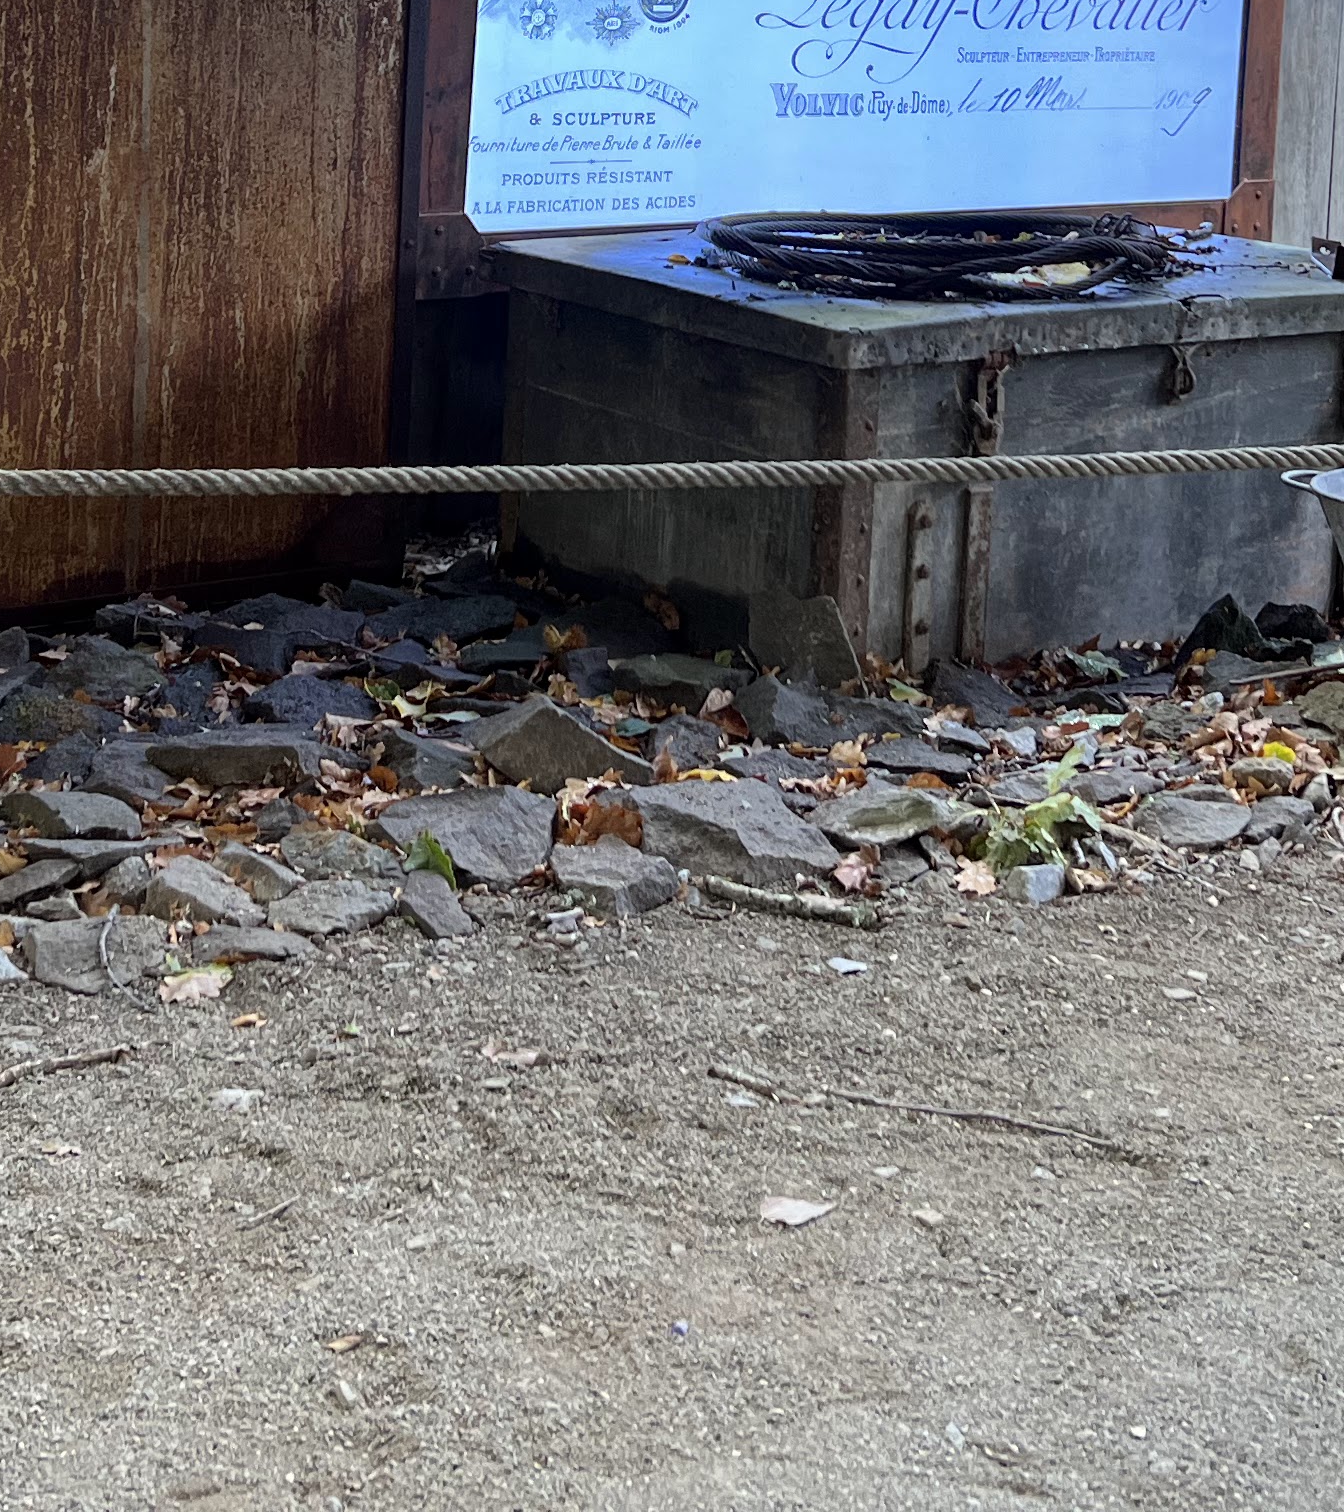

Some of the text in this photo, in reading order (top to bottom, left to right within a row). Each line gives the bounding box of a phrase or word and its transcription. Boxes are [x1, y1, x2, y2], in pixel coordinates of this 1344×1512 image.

[957, 47, 1009, 63] SCULPTEUR
[494, 69, 699, 119] TRAVAUX D'ART
[769, 82, 864, 118] VOLVIC
[529, 112, 656, 126] & SCULPTURE
[469, 133, 702, 153] Fourniture de Pierre Brute & Taillée
[501, 166, 673, 186] PRODUITS RÉSISTANT
[472, 195, 696, 215] A LA FABRICATION DES ACIDES
